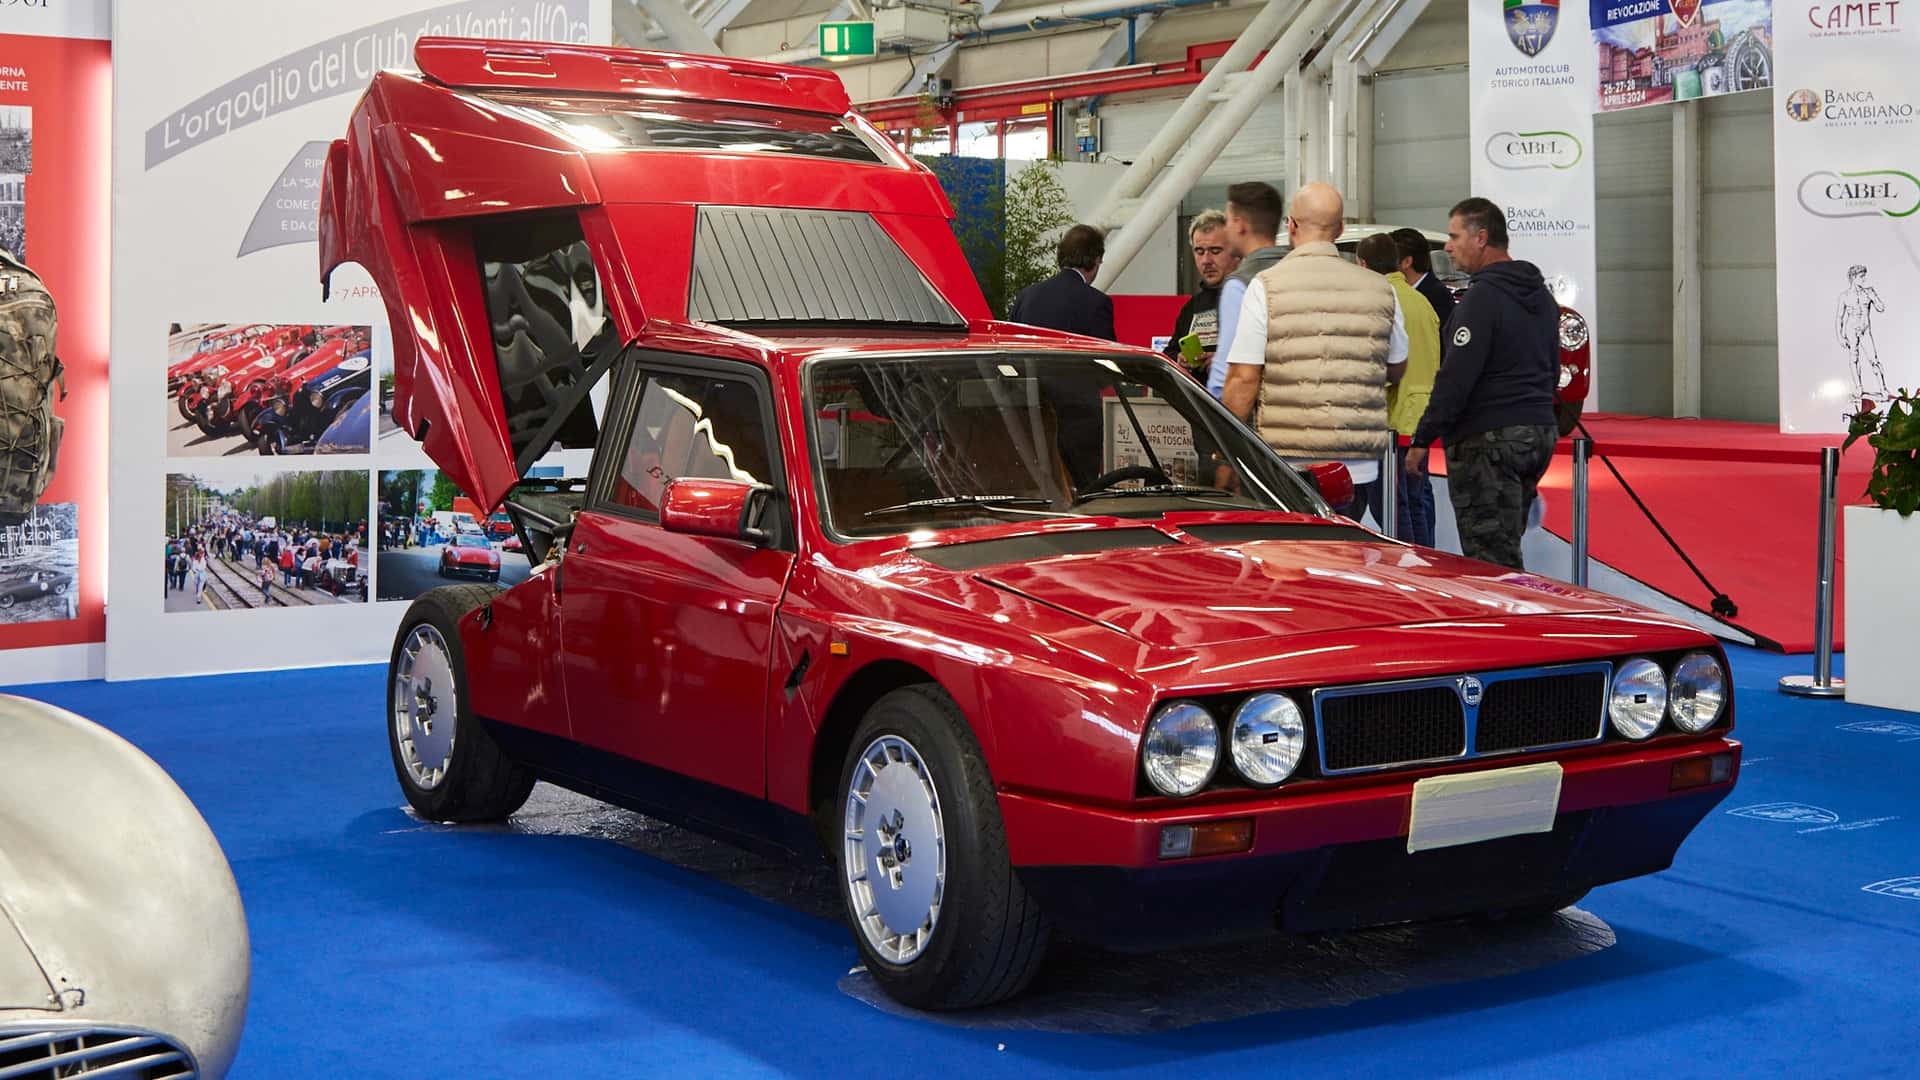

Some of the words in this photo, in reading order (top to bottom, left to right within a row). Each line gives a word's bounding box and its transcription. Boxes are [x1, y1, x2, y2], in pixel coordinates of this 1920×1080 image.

[1607, 1, 1660, 20] RIEVOCAZIONE
[1808, 1, 1900, 29] CAMET
[1495, 64, 1570, 76] AUTOMOTOCLUB
[163, 67, 301, 149] L'orgoglio
[308, 42, 347, 93] del
[353, 25, 408, 79] Club
[1490, 78, 1530, 88] STORICO
[1532, 76, 1575, 87] ITALIANO
[1824, 89, 1875, 104] BANCA
[1824, 103, 1913, 120] CAMBIANO
[1507, 141, 1563, 156] CABEL
[1825, 182, 1898, 200] CABEL
[276, 200, 309, 210] COME
[1507, 207, 1546, 219] BANCA
[1506, 219, 1575, 232] CAMBIANO
[1147, 424, 1187, 435] LOCANDINE
